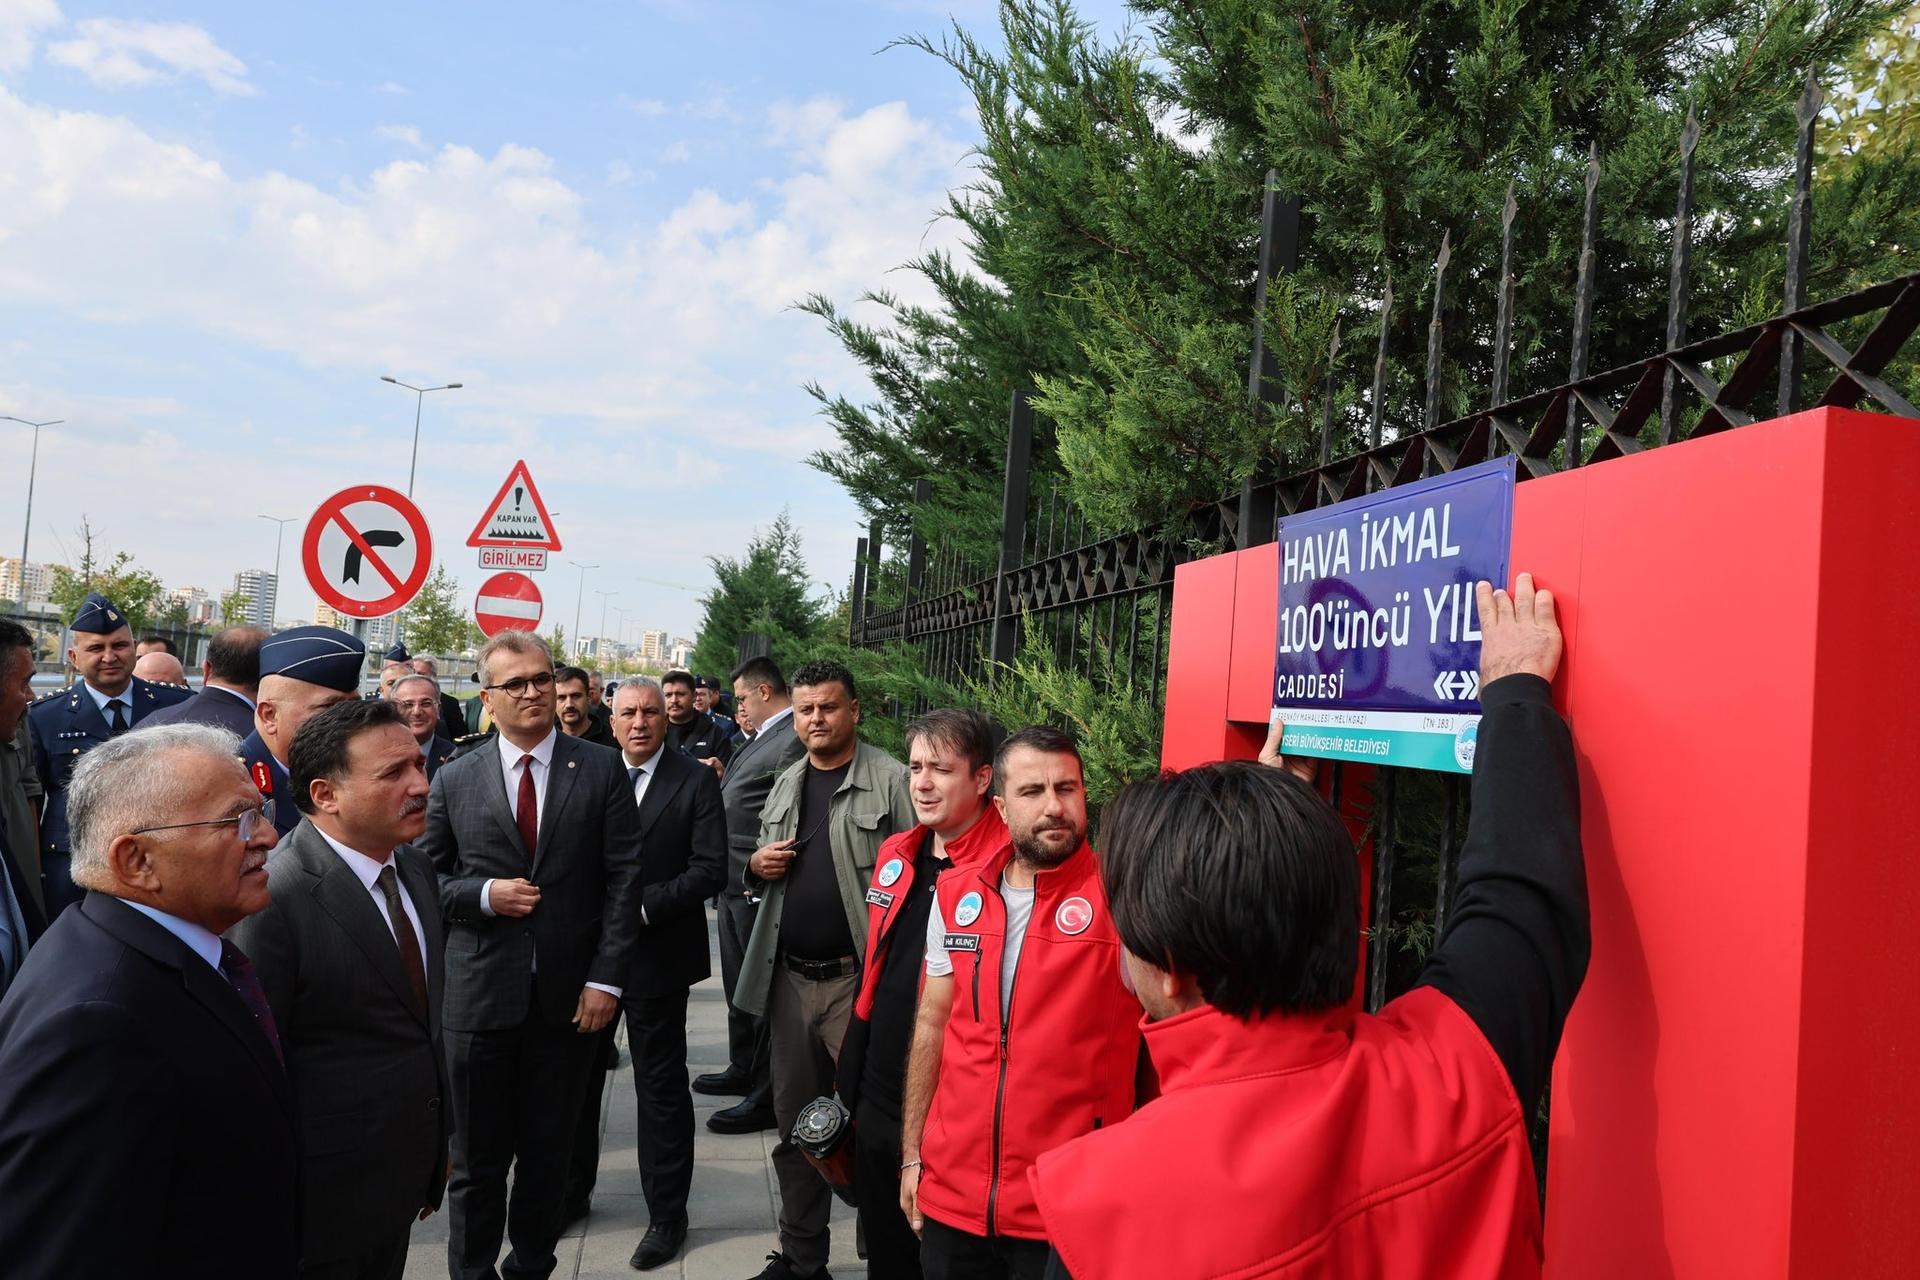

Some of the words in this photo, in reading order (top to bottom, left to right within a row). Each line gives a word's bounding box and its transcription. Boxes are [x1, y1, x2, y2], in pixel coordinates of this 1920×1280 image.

[497, 514, 521, 523] KAPAN
[523, 515, 537, 524] VAR
[1283, 528, 1350, 585] HAVA
[1360, 503, 1460, 572] İKMAL
[482, 549, 543, 567] GİRİLMEZ
[1279, 592, 1411, 653] 100'üncü
[1423, 581, 1482, 643] YIL
[1278, 668, 1344, 698] CADDESİ
[1300, 734, 1343, 752] BÜYÜKŞEHİR
[1343, 737, 1390, 756] BELEDİYESİ
